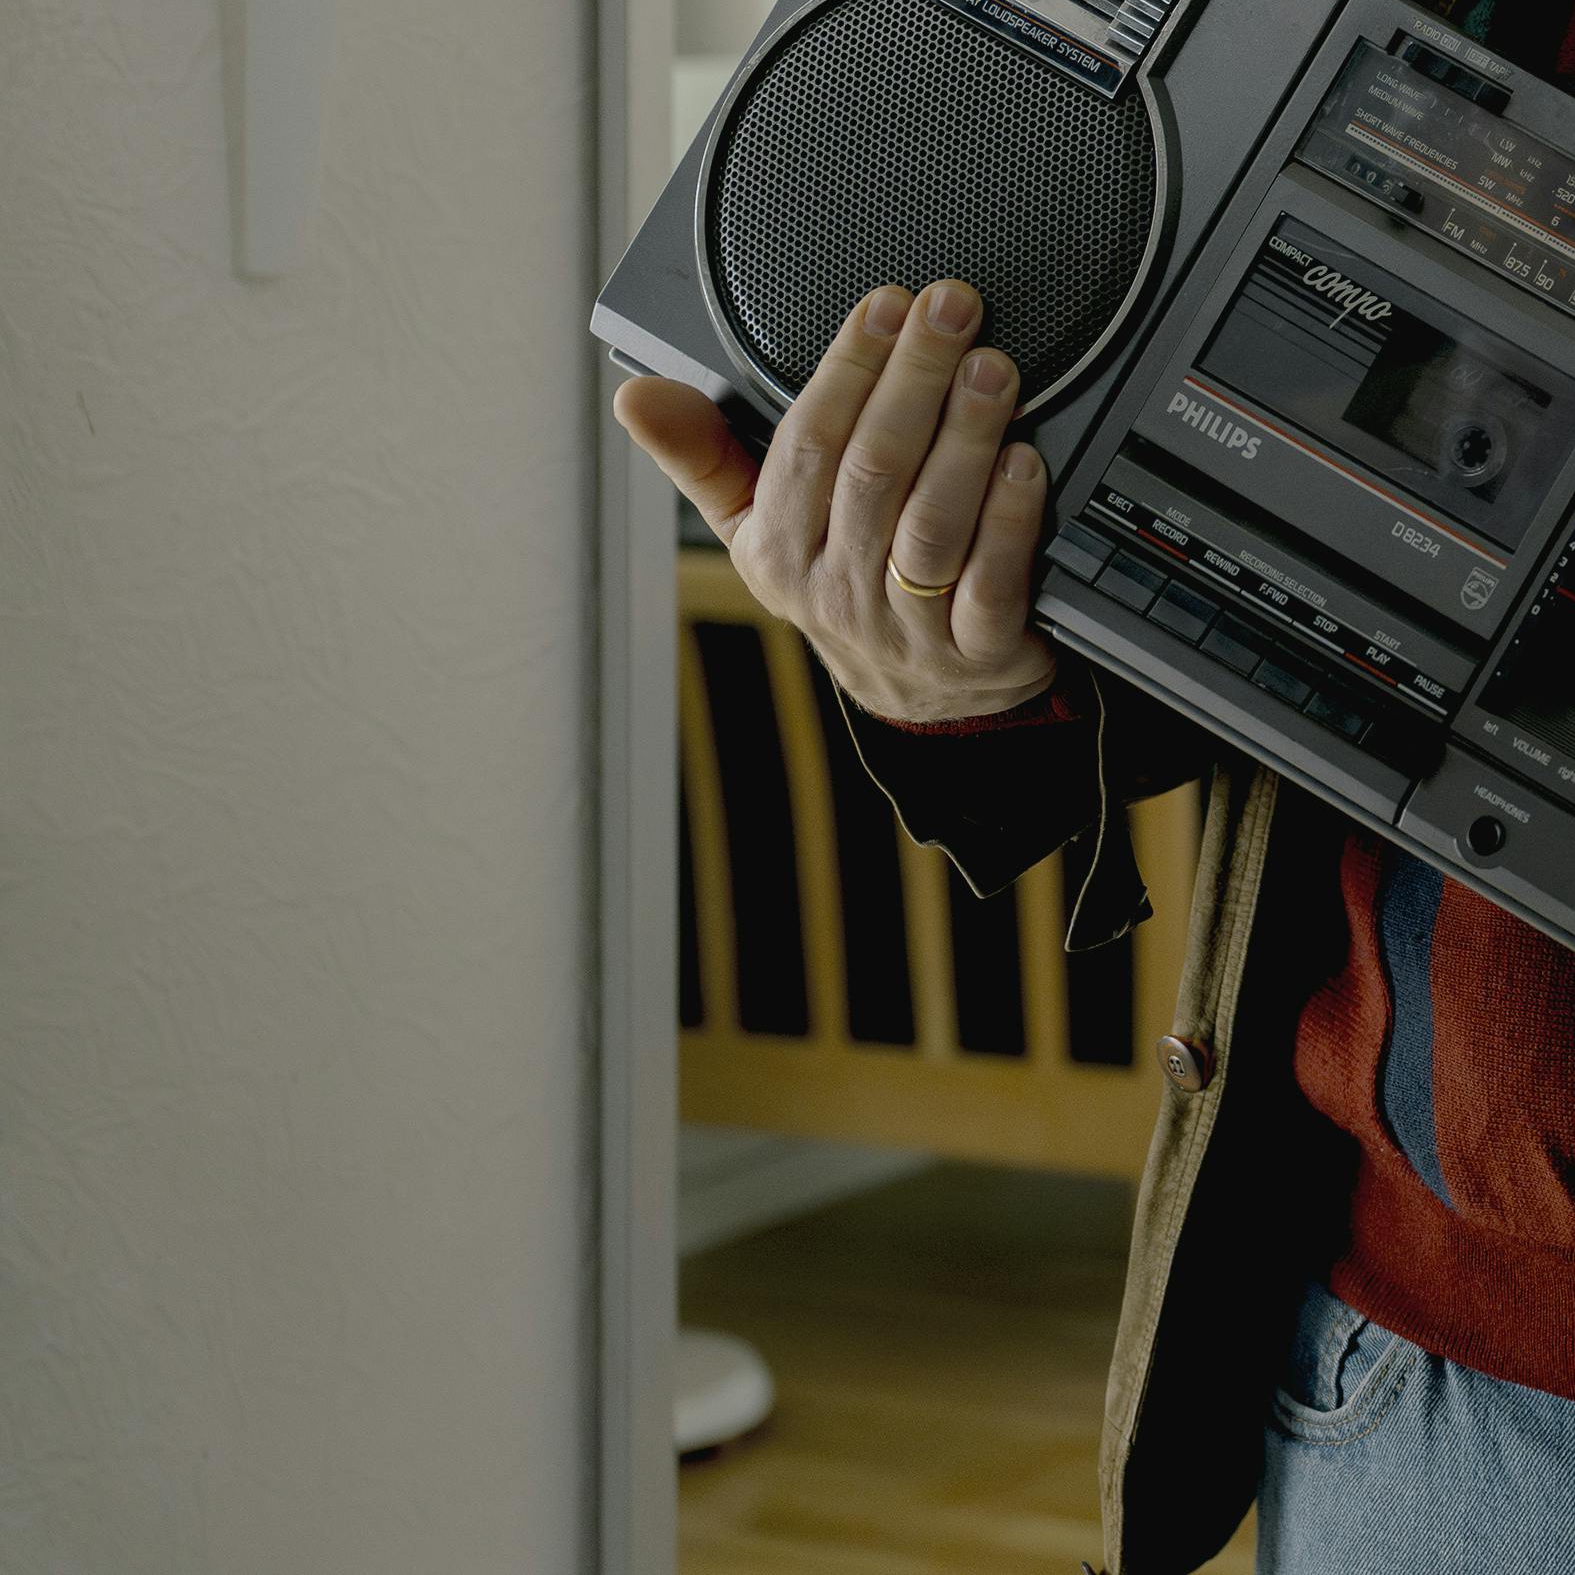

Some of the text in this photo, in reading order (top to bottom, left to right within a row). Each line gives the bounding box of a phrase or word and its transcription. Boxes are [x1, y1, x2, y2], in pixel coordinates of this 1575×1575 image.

[982, 1, 1058, 48] LOUDSPEAKER
[1056, 42, 1101, 73] SYSTEM
[1413, 20, 1441, 41] RADIO
[1376, 71, 1424, 101] LONG WAVE
[1368, 85, 1424, 121] MEDIUM WAVE
[1355, 107, 1458, 170] SHORT WAVE FREQUENCIES
[1499, 138, 1516, 153] LW
[1491, 151, 1512, 168] MW
[1555, 187, 1575, 204] 520
[1477, 175, 1497, 190] SW
[1551, 215, 1561, 227] 6
[1443, 221, 1465, 241] FM
[1505, 256, 1531, 278] 87.5
[1535, 273, 1555, 291] 90
[1269, 236, 1392, 330] COMPACT compo
[1167, 393, 1261, 459] PHILIPS
[1107, 492, 1134, 513] EJECT
[1166, 507, 1192, 527] MODE
[1152, 519, 1189, 546] RECORD
[1204, 550, 1240, 576] REWIND
[1558, 556, 1569, 568] 3
[1238, 550, 1327, 607] RECORDING SELECTION
[1549, 572, 1559, 583] 2
[1259, 583, 1289, 606] F.FWD
[1542, 588, 1549, 599] 1
[1531, 604, 1541, 616] 0
[1313, 615, 1338, 633] STOP
[1373, 630, 1401, 650] START
[1366, 646, 1391, 665] PLAY
[1414, 674, 1445, 699] PAUSE
[1483, 720, 1499, 736] left
[1513, 737, 1551, 766] VOLUME
[1474, 785, 1530, 823] HEADPHONES
